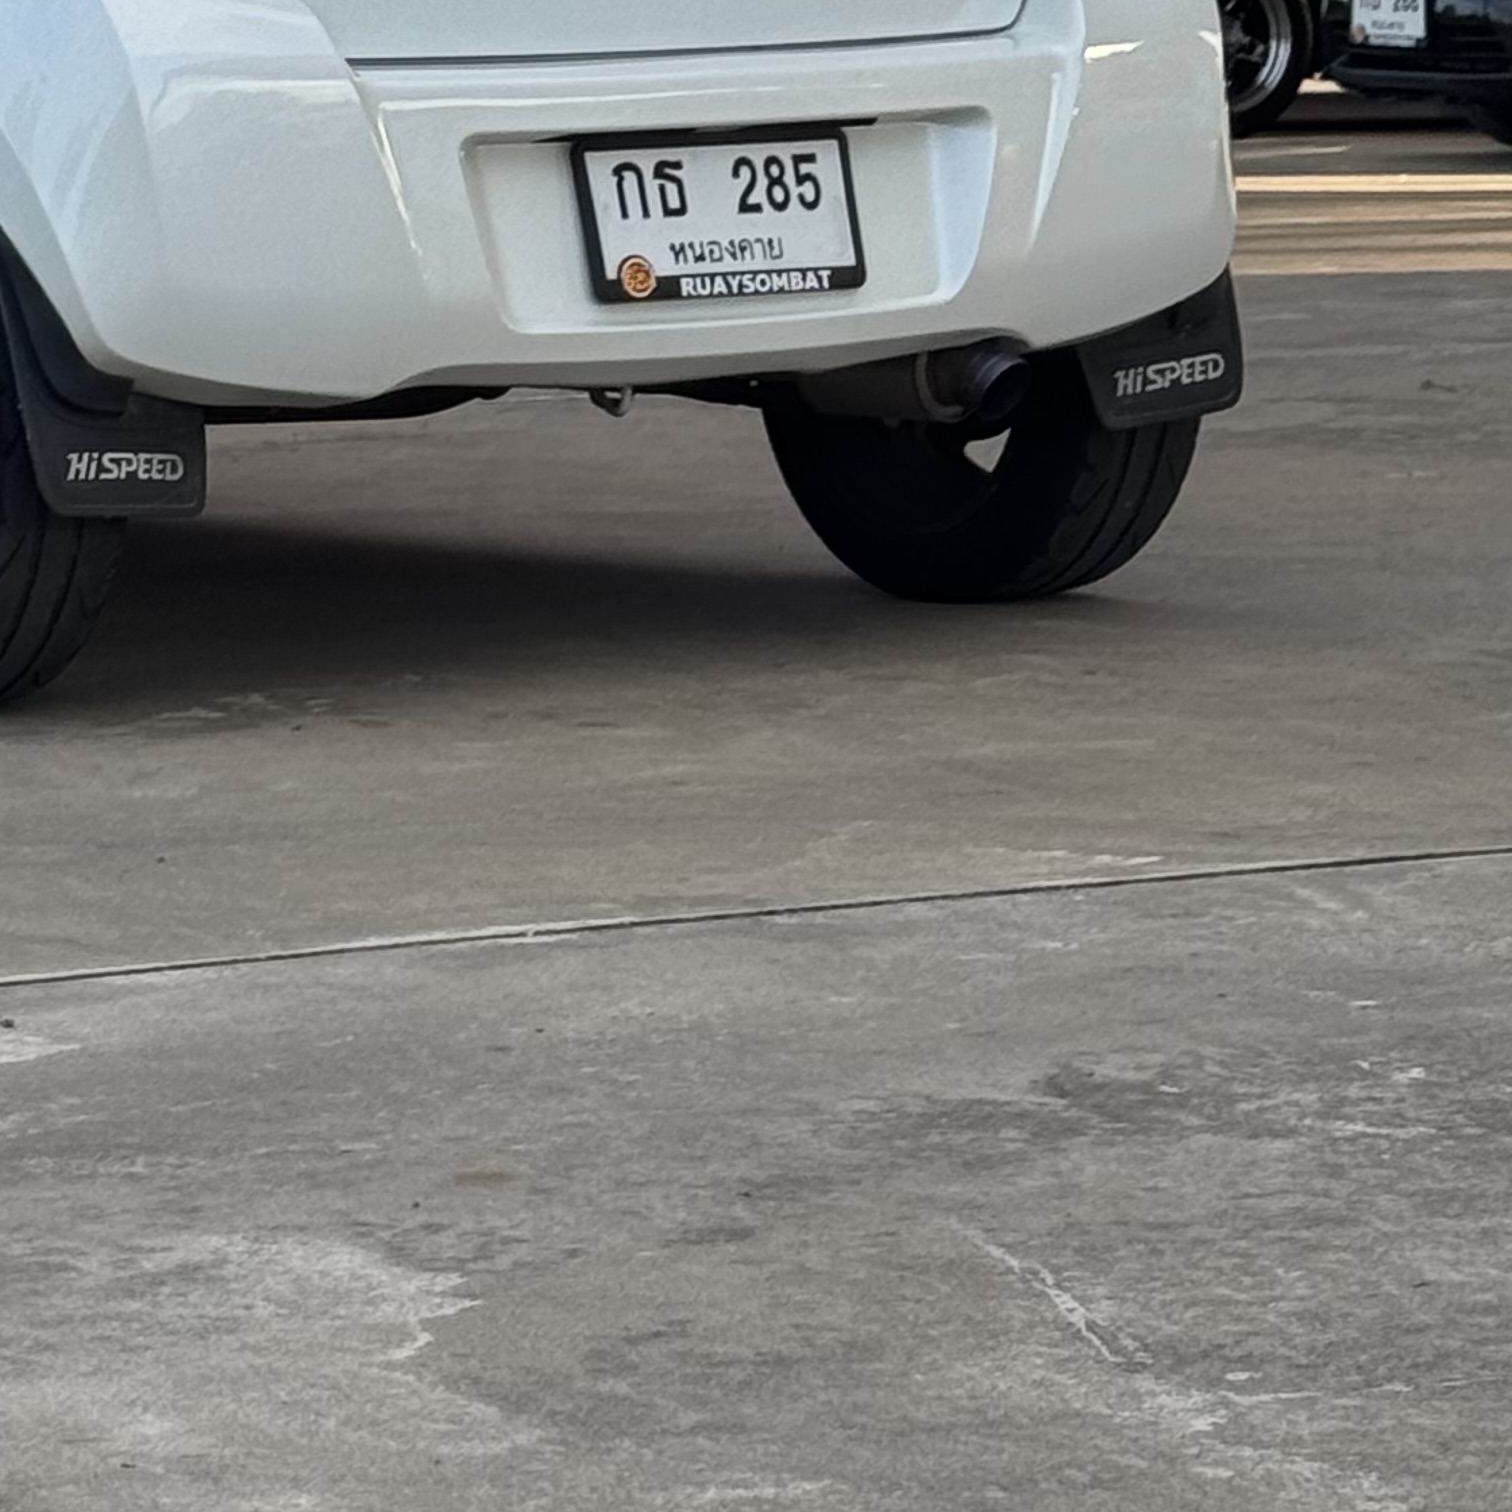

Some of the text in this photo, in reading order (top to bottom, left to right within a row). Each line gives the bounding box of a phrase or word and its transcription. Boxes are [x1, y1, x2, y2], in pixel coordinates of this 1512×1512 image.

[611, 152, 822, 220] กธ 285
[669, 236, 784, 266] หนองคาย
[679, 269, 832, 298] RUAYSOMBAT
